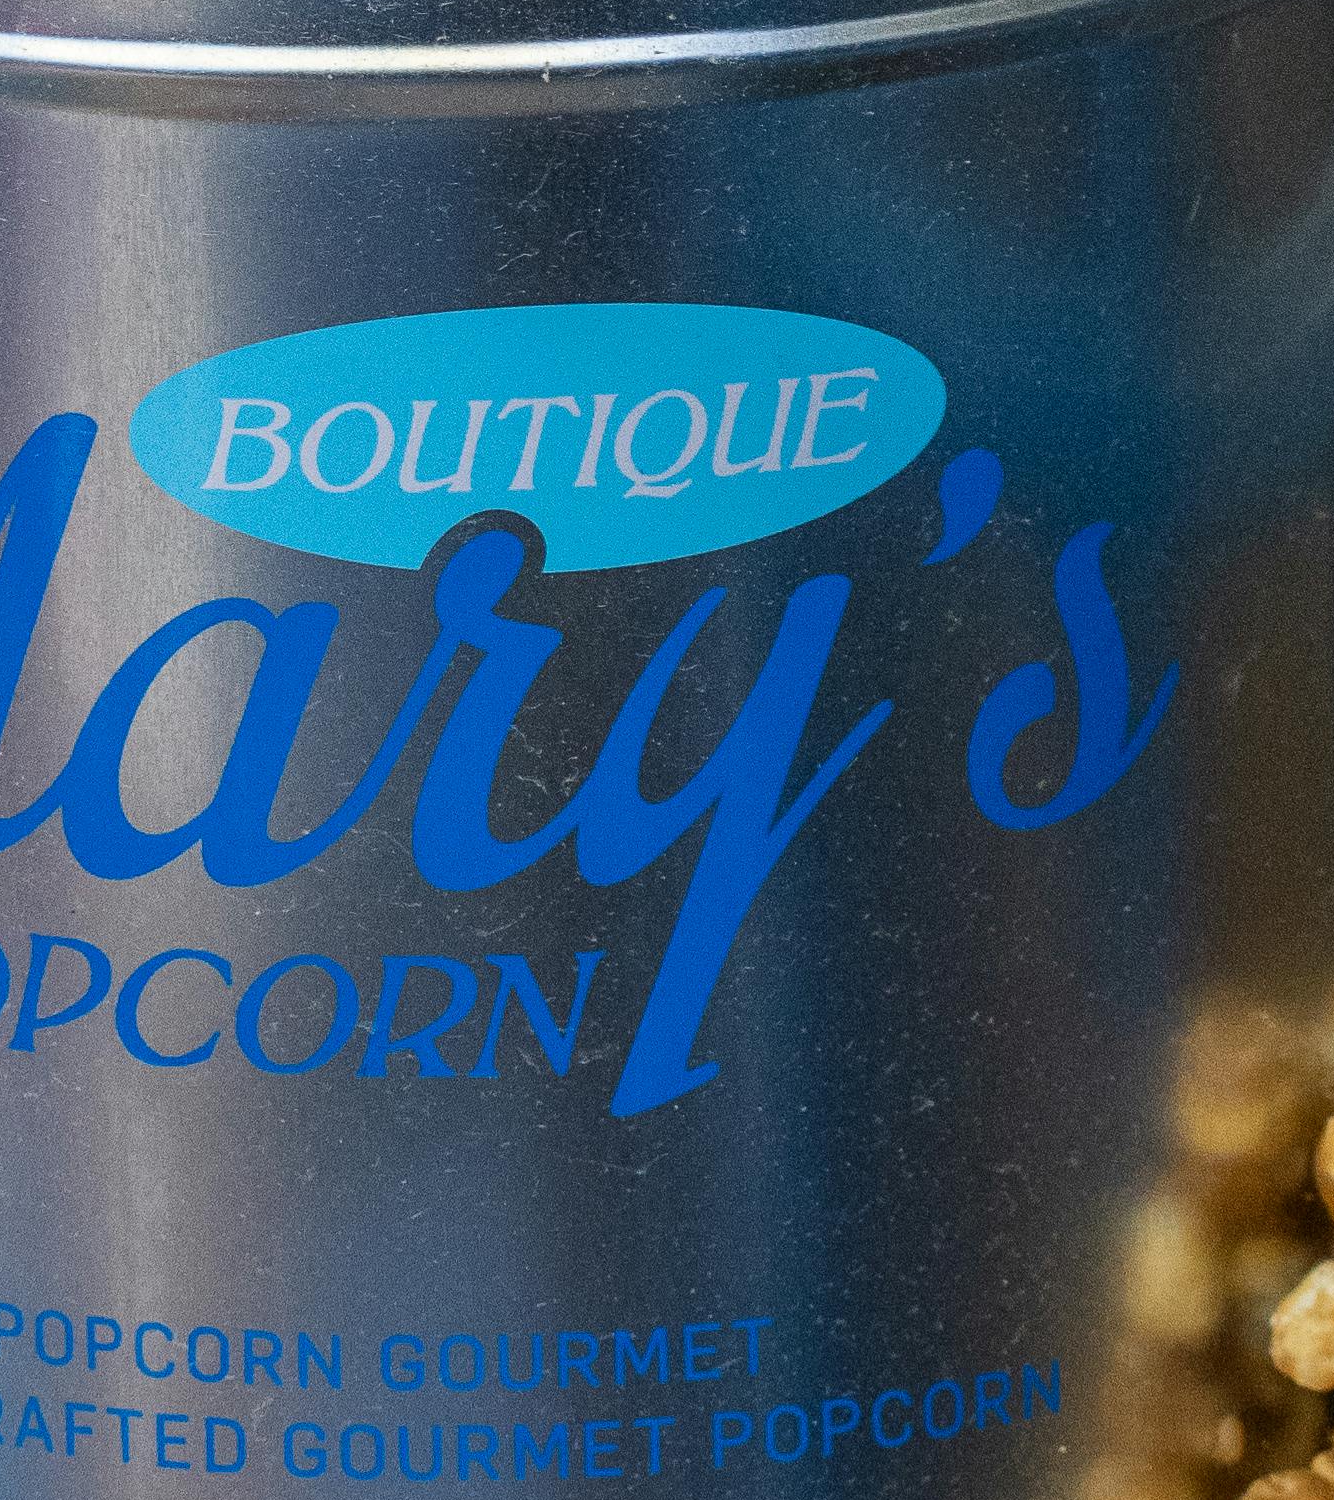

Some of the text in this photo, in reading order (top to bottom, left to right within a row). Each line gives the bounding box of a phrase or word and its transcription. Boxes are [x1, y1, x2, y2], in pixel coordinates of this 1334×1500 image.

[200, 367, 881, 500] BOUTIQUE
[379, 1316, 776, 1393] GOURMET
[281, 1416, 677, 1483] GOURMET
[712, 1358, 1064, 1470] POPCORN
